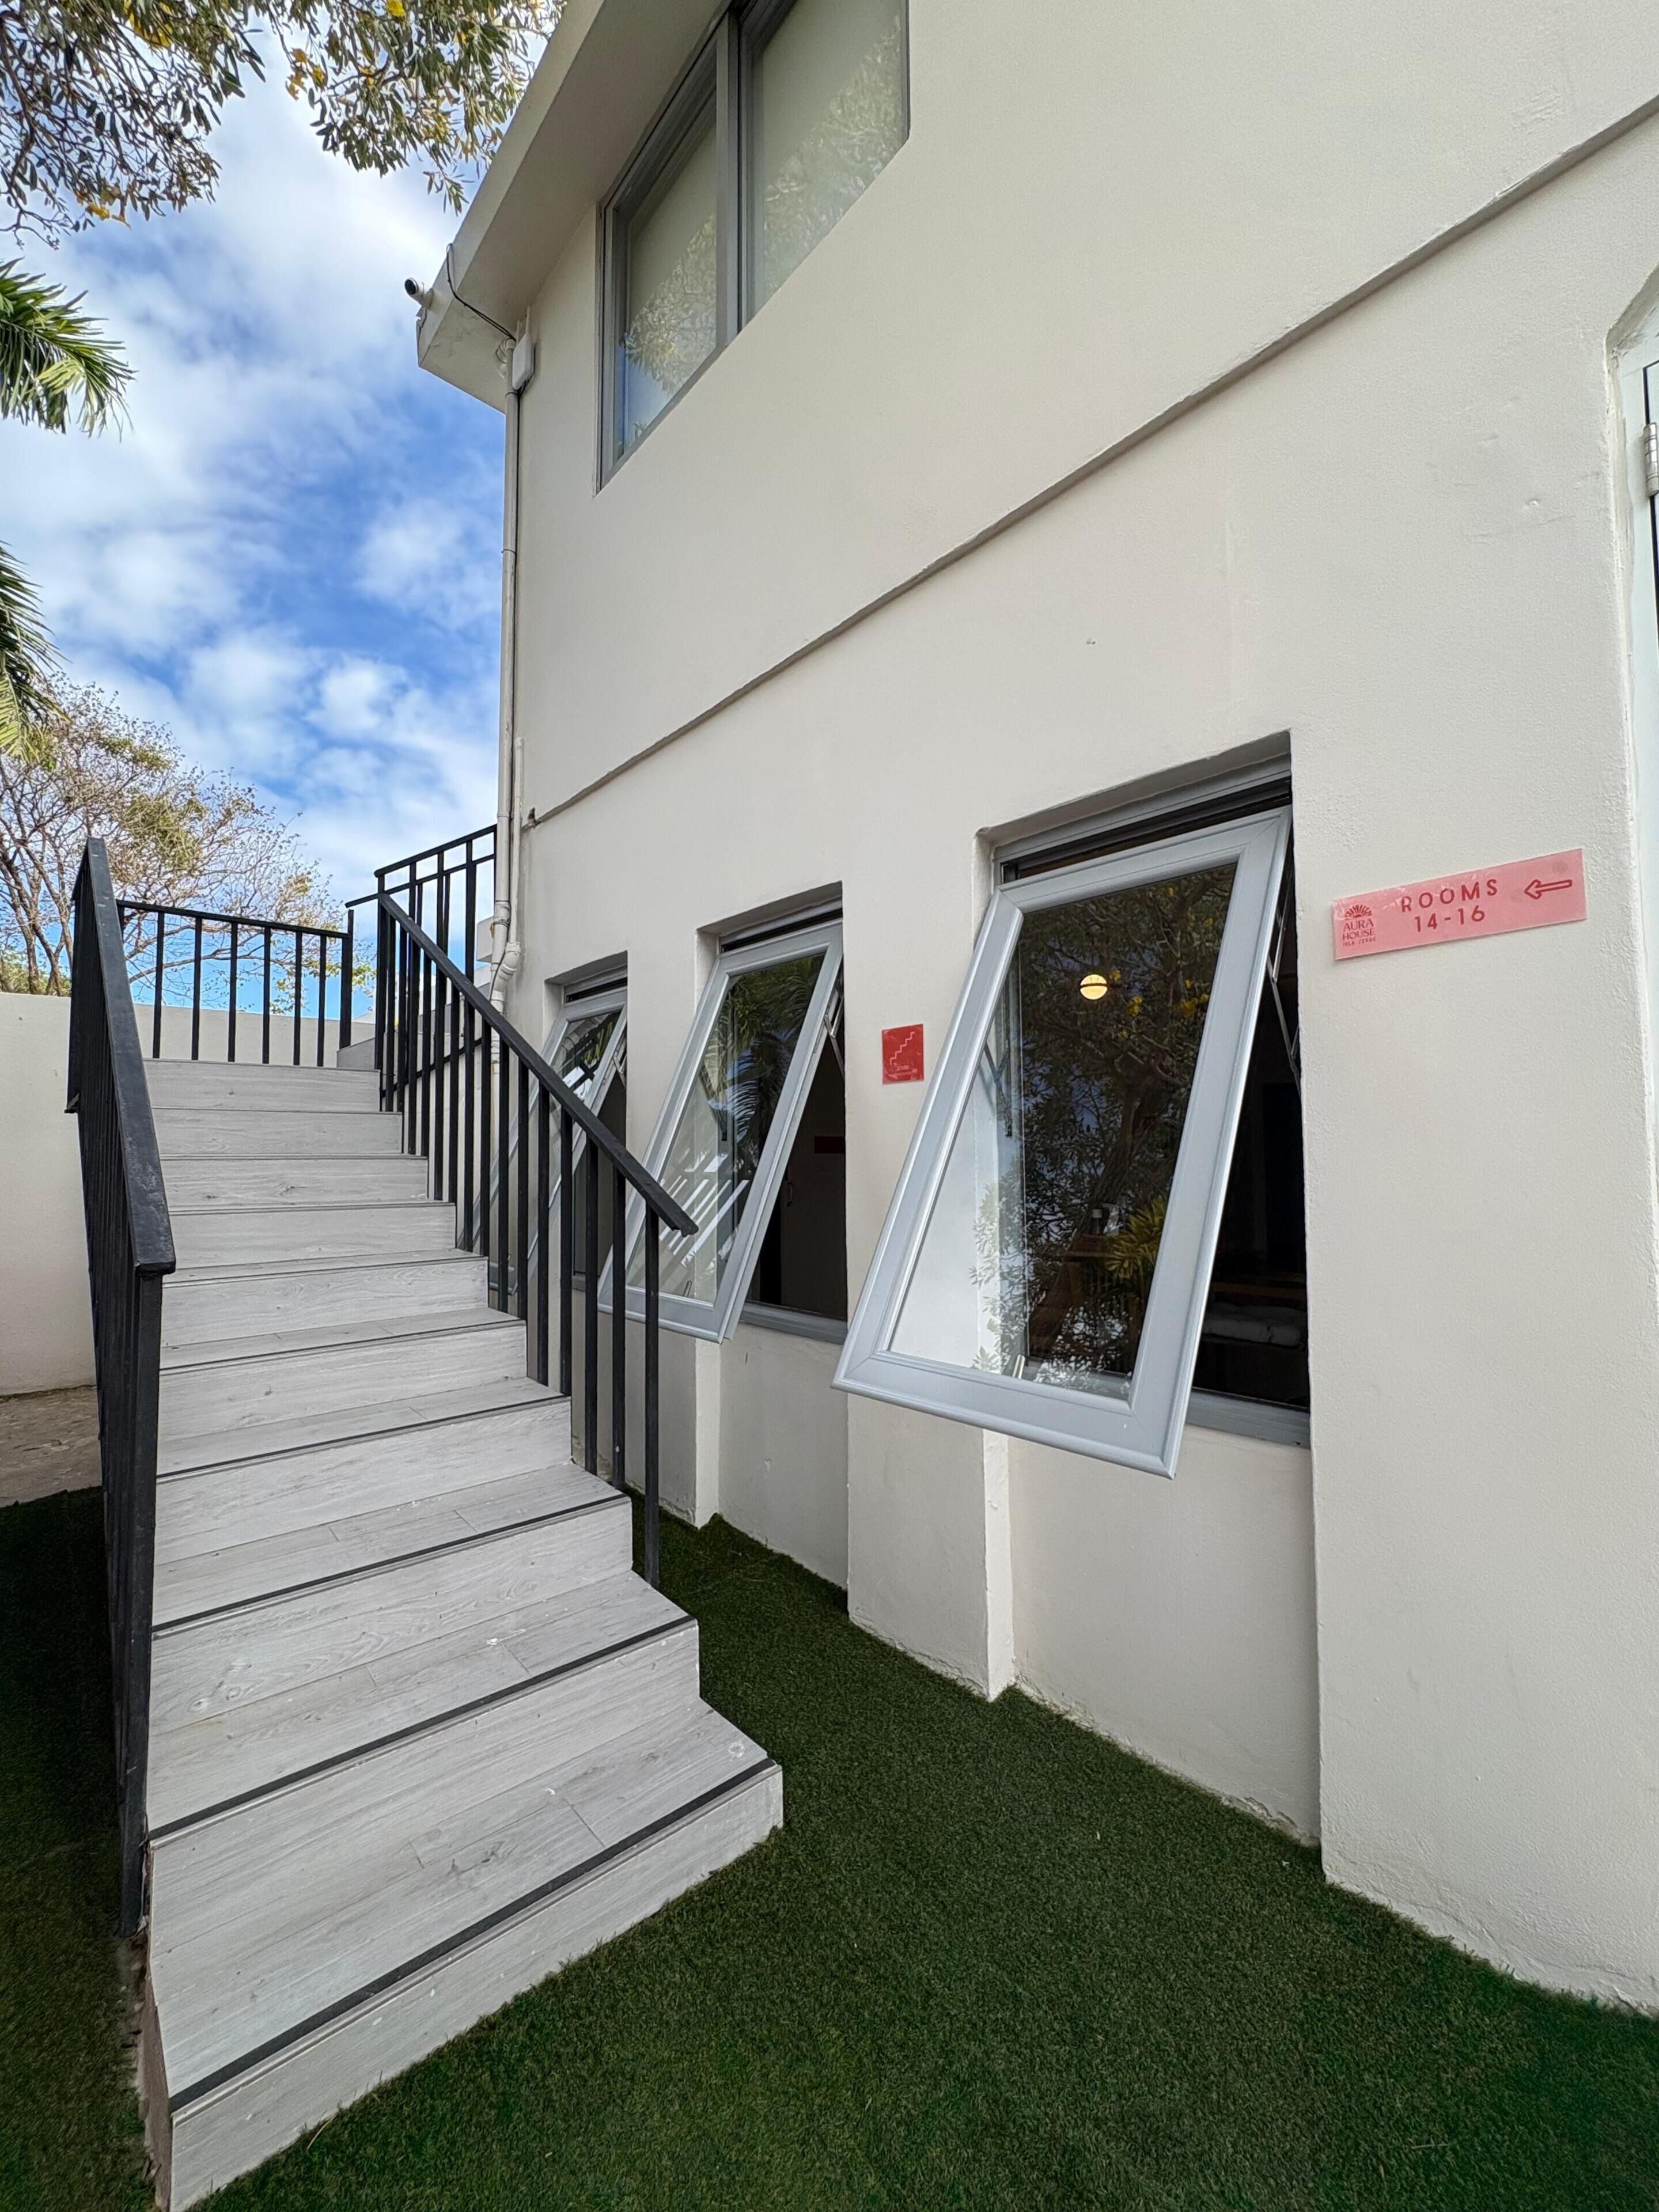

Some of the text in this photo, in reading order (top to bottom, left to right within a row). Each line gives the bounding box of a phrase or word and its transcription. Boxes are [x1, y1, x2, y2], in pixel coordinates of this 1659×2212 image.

[1402, 879, 1498, 912] ROOMS
[1343, 918, 1374, 932] AURA
[1415, 905, 1485, 932] 14-16
[1342, 928, 1376, 941] HOUSE
